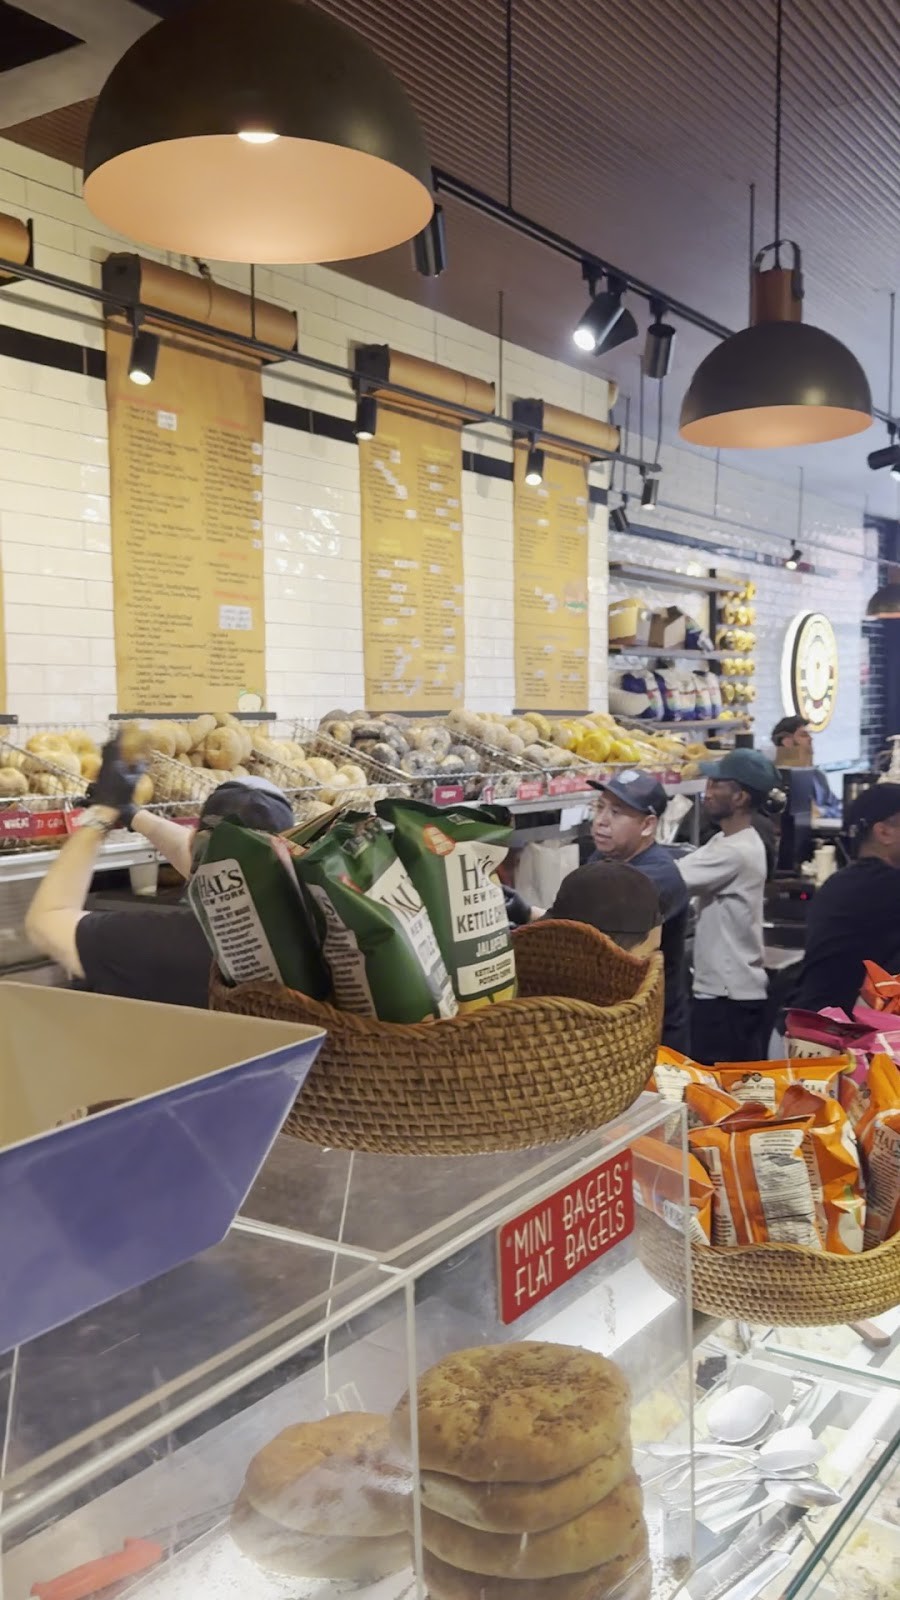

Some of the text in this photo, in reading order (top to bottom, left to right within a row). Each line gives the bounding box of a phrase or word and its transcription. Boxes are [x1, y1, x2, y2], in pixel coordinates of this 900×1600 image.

[219, 888, 245, 902] YORK
[457, 909, 493, 934] KETTLE
[514, 1163, 623, 1264] MINI BAGELS
[514, 1200, 625, 1306] FLAT BAGELS
